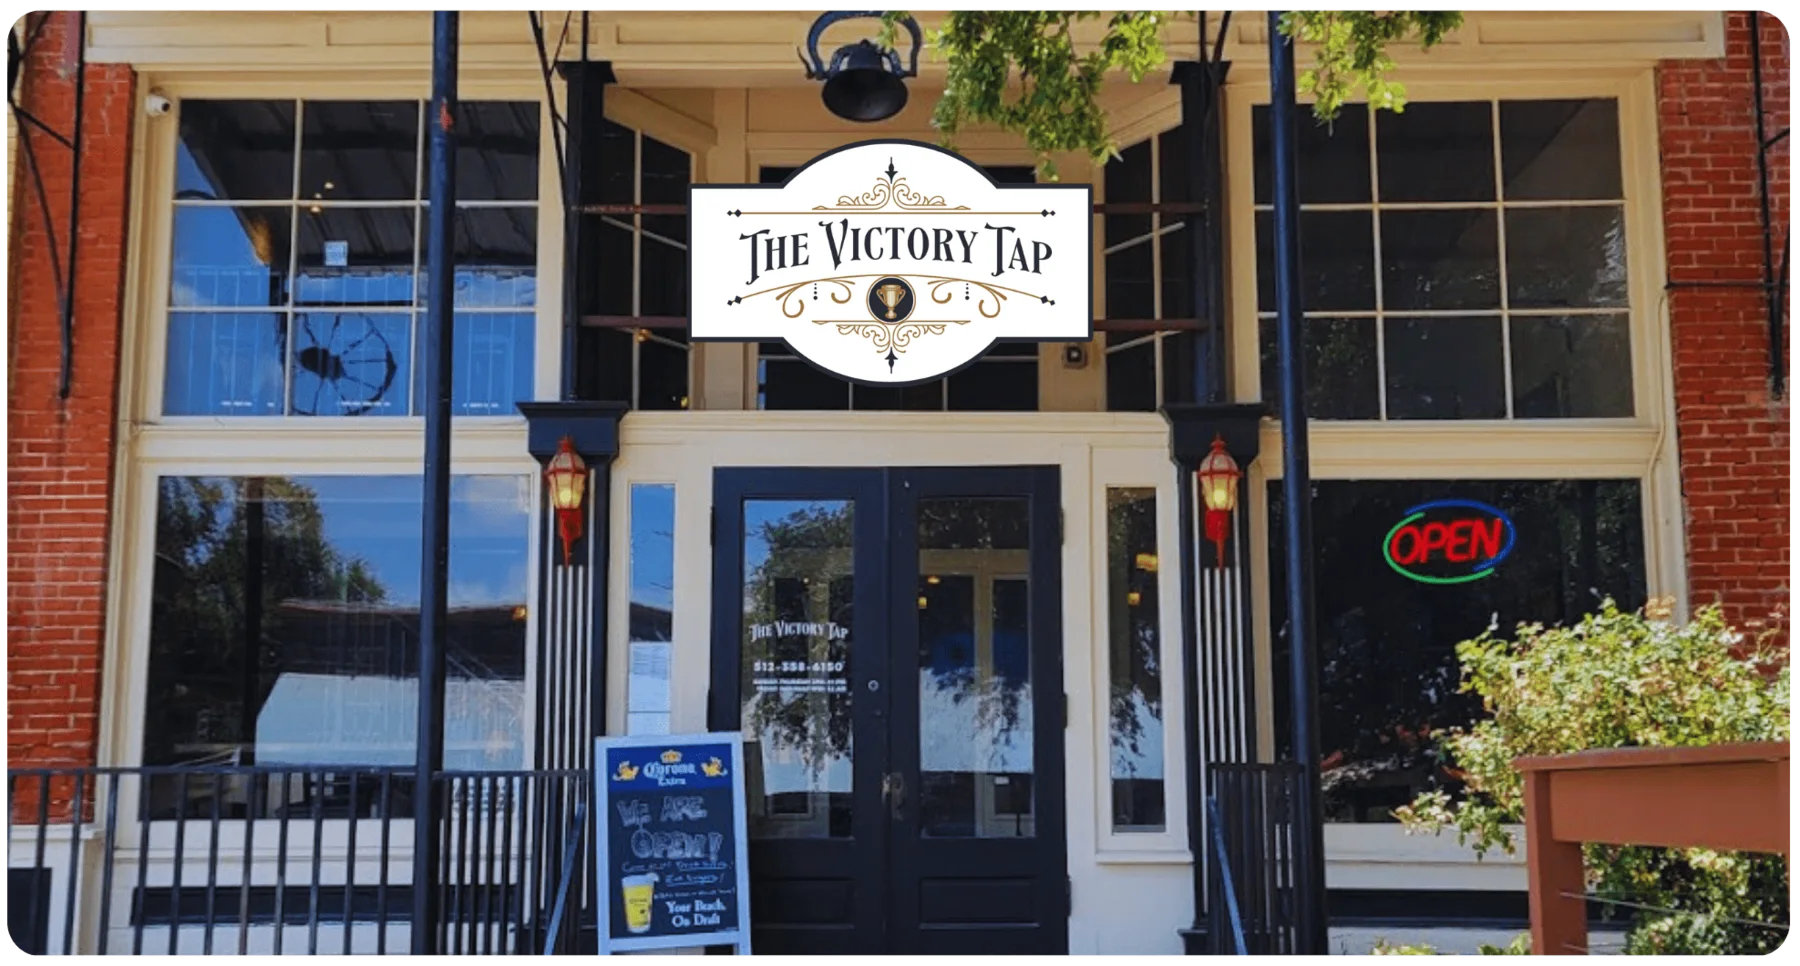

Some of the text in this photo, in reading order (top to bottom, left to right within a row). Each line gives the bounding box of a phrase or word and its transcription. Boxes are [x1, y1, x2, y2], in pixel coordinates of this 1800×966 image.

[739, 218, 1053, 285] THE VICTORY TAP
[1391, 518, 1502, 564] OPEN
[749, 620, 849, 642] THE VICTORY TAP
[642, 761, 697, 779] Corona
[658, 778, 686, 787] Extra
[660, 796, 708, 821] ARE
[666, 901, 692, 914] Your
[672, 913, 721, 928] On Draft
